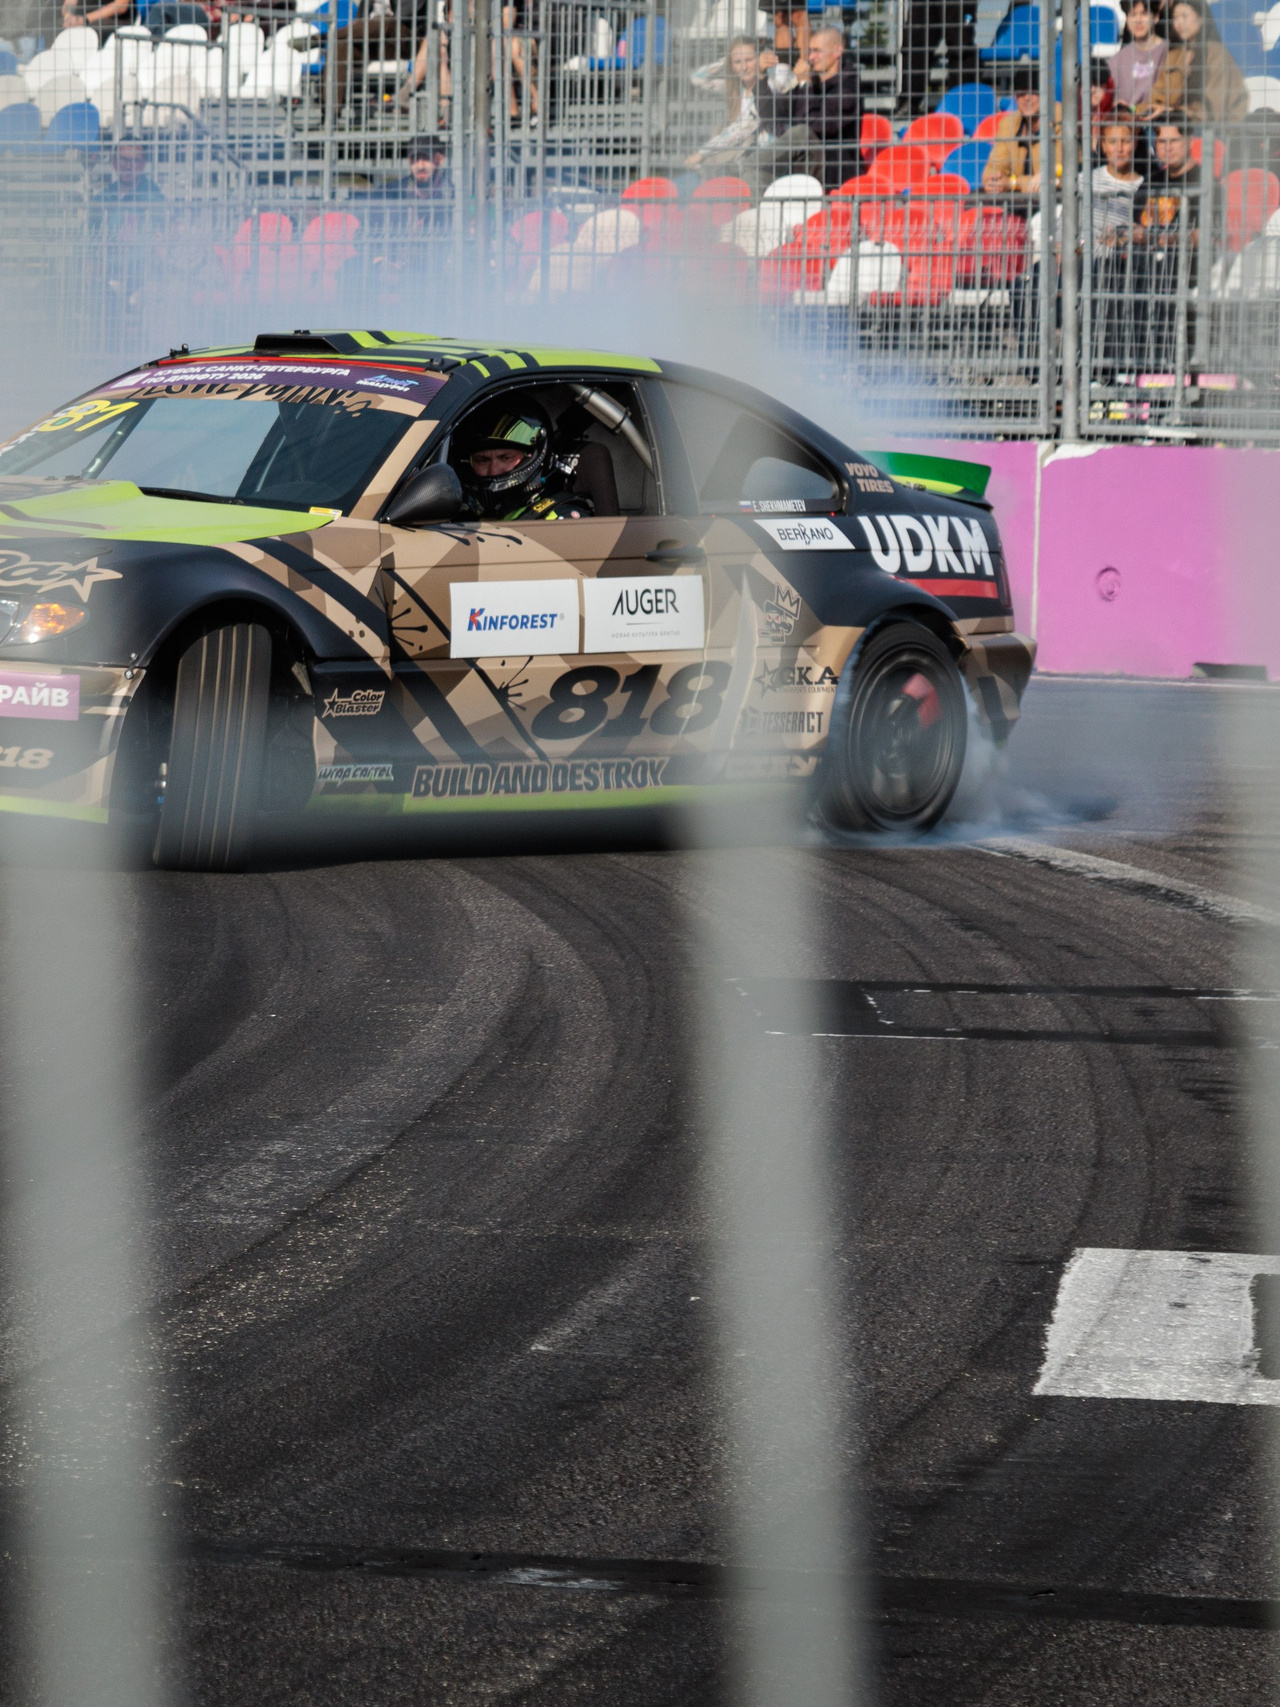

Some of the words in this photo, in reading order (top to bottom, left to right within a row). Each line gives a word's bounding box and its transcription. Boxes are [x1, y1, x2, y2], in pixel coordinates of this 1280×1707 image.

[141, 376, 164, 385] ПО
[164, 373, 229, 384] ДРИФТУ
[228, 373, 266, 381] 2026
[153, 366, 206, 377] КУБОК
[205, 364, 351, 377] САНКТ-ПЕТЕРБУРГА
[856, 478, 895, 494] TIRES
[776, 523, 835, 546] BERKANO
[857, 514, 995, 576] UDKM
[611, 588, 681, 616] AUGER
[352, 690, 385, 703] Color
[531, 660, 733, 741] 818
[334, 702, 381, 715] Blaster
[762, 711, 824, 734] TESSERACT
[412, 765, 493, 798] BUILD
[491, 762, 552, 796] AND
[550, 757, 670, 792] DESTROY
